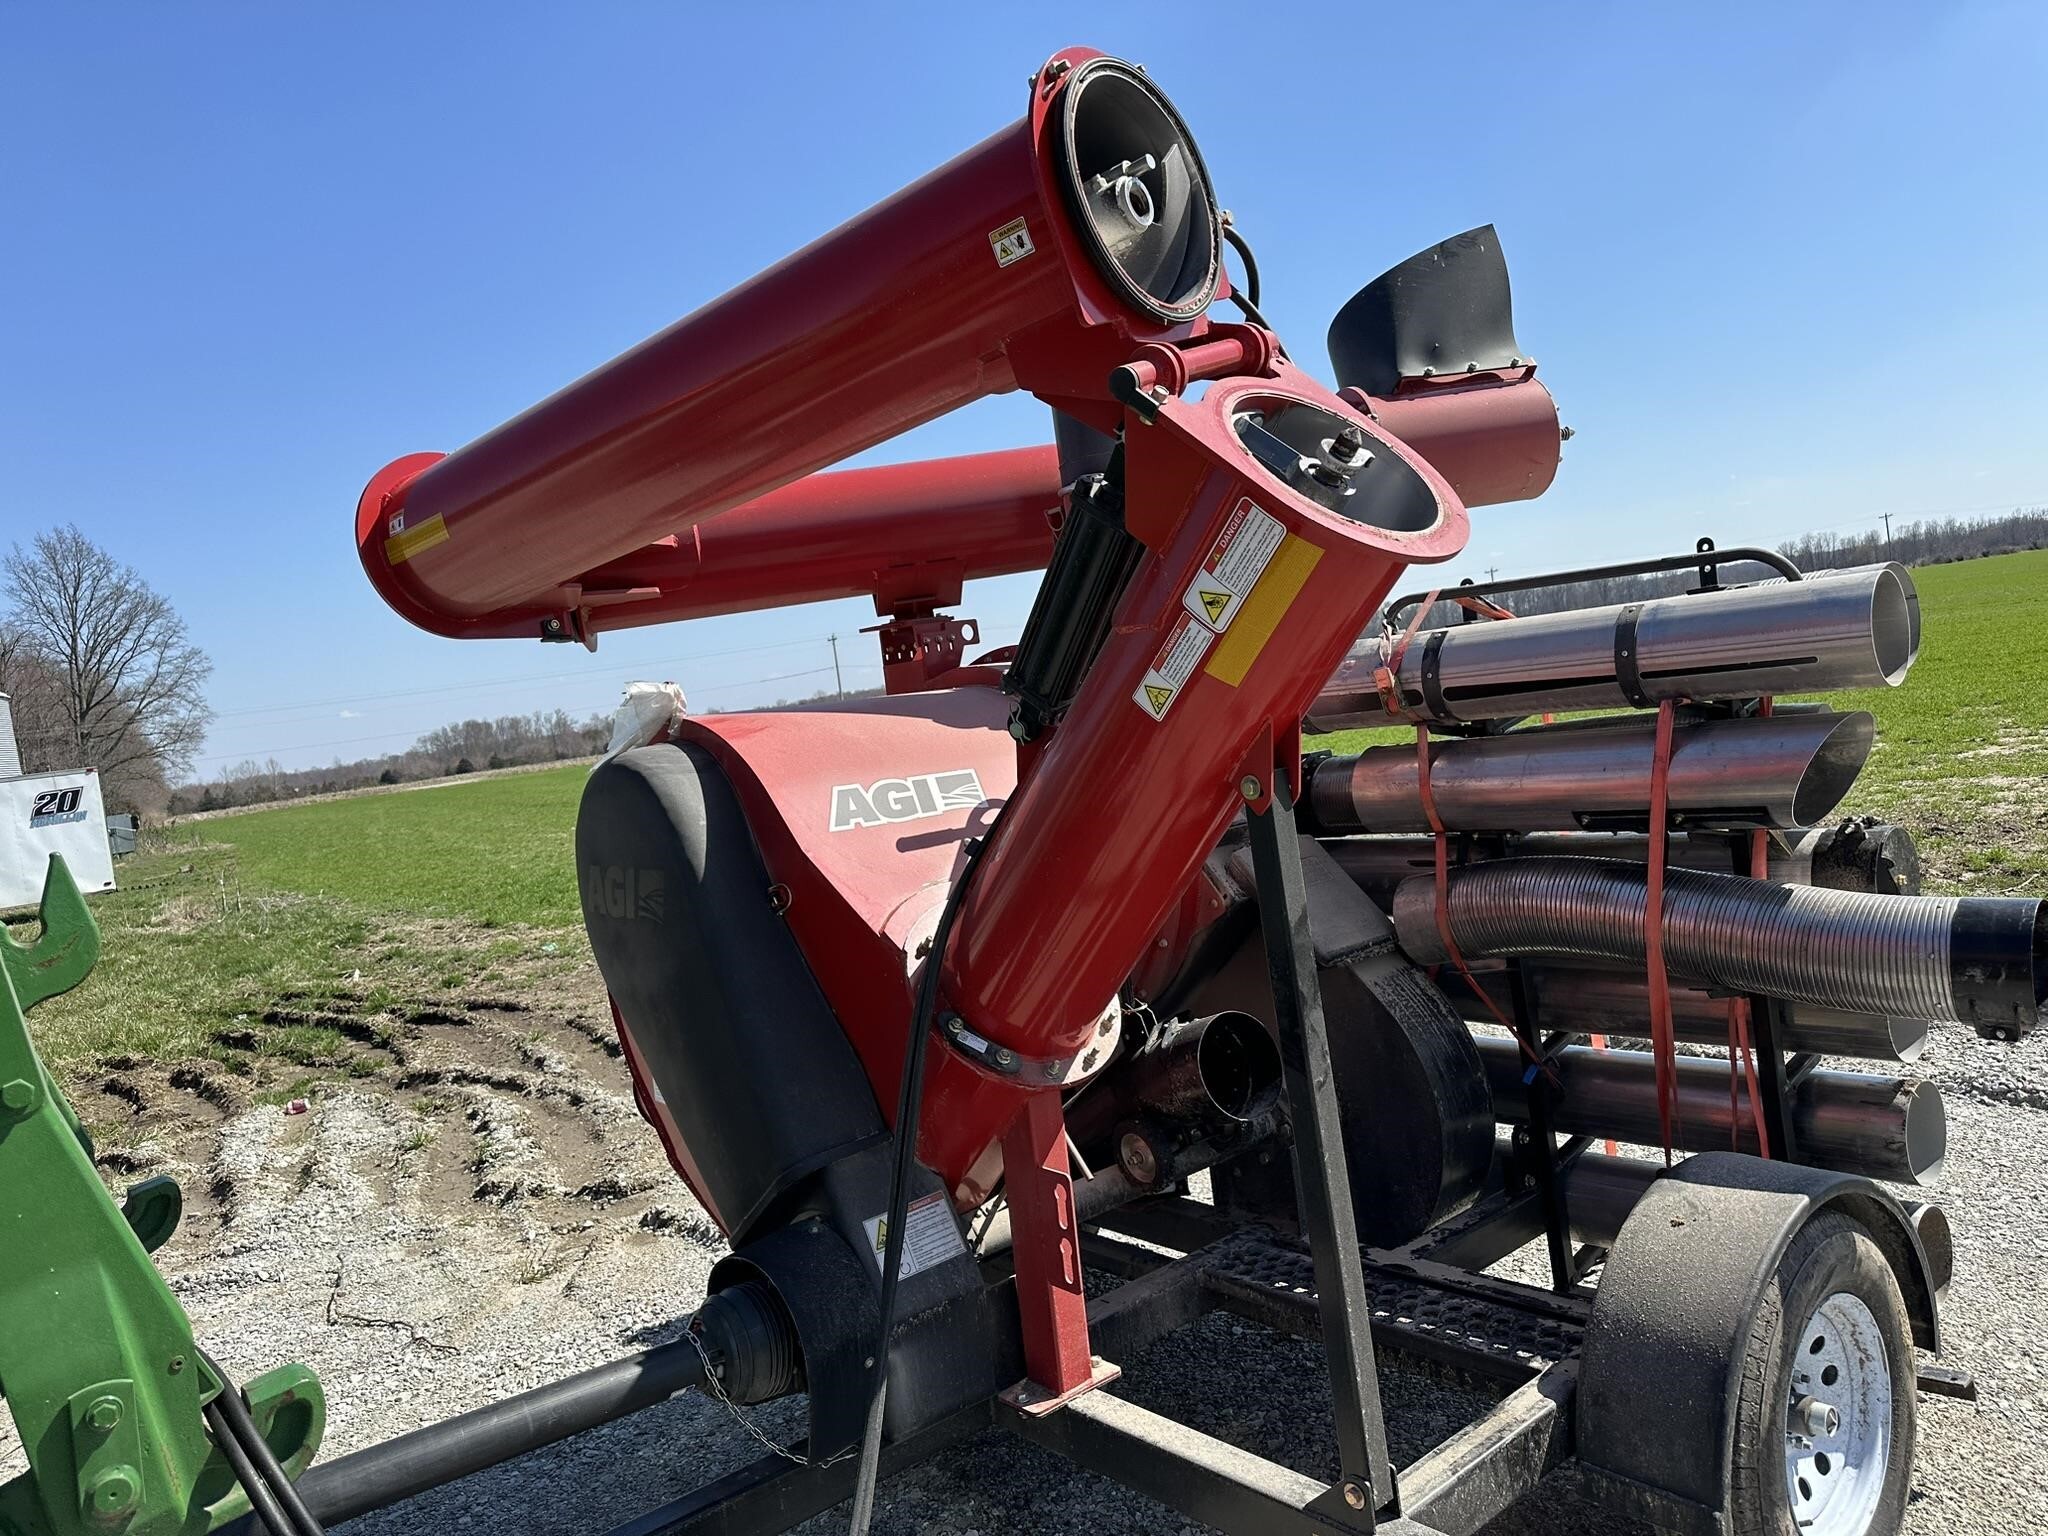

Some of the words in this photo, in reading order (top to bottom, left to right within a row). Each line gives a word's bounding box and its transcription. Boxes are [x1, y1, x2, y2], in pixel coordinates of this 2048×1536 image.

[998, 220, 1024, 238] WARNING
[1219, 510, 1246, 549] DANGER
[1165, 628, 1182, 652] DANGER
[30, 786, 84, 820] 20
[832, 777, 939, 829] AGI
[587, 865, 636, 919] AGI
